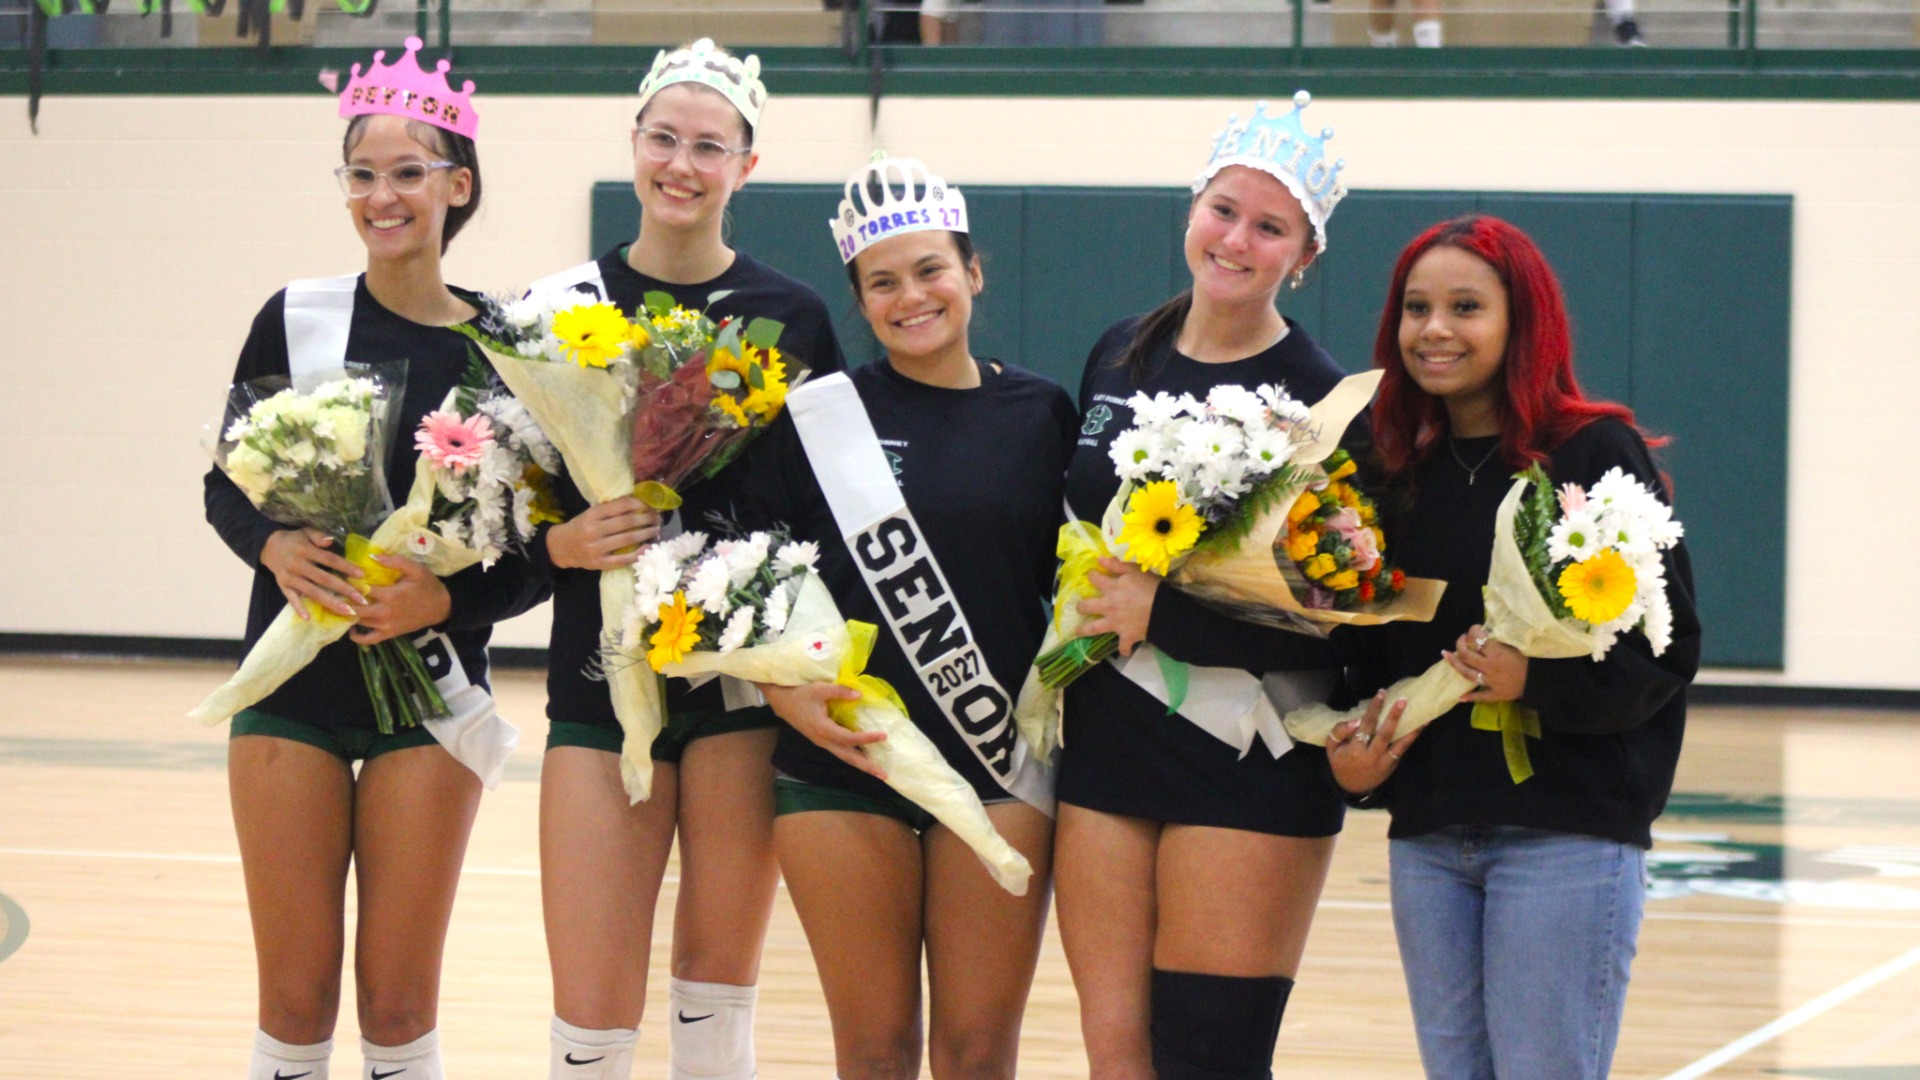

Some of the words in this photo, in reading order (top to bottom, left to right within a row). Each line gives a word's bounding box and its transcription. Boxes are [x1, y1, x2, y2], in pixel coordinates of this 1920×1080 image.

[351, 86, 460, 125] PEYTON
[839, 234, 856, 260] 20
[858, 208, 931, 242] TORRES
[938, 208, 960, 227] 27
[928, 649, 981, 697] 2027
